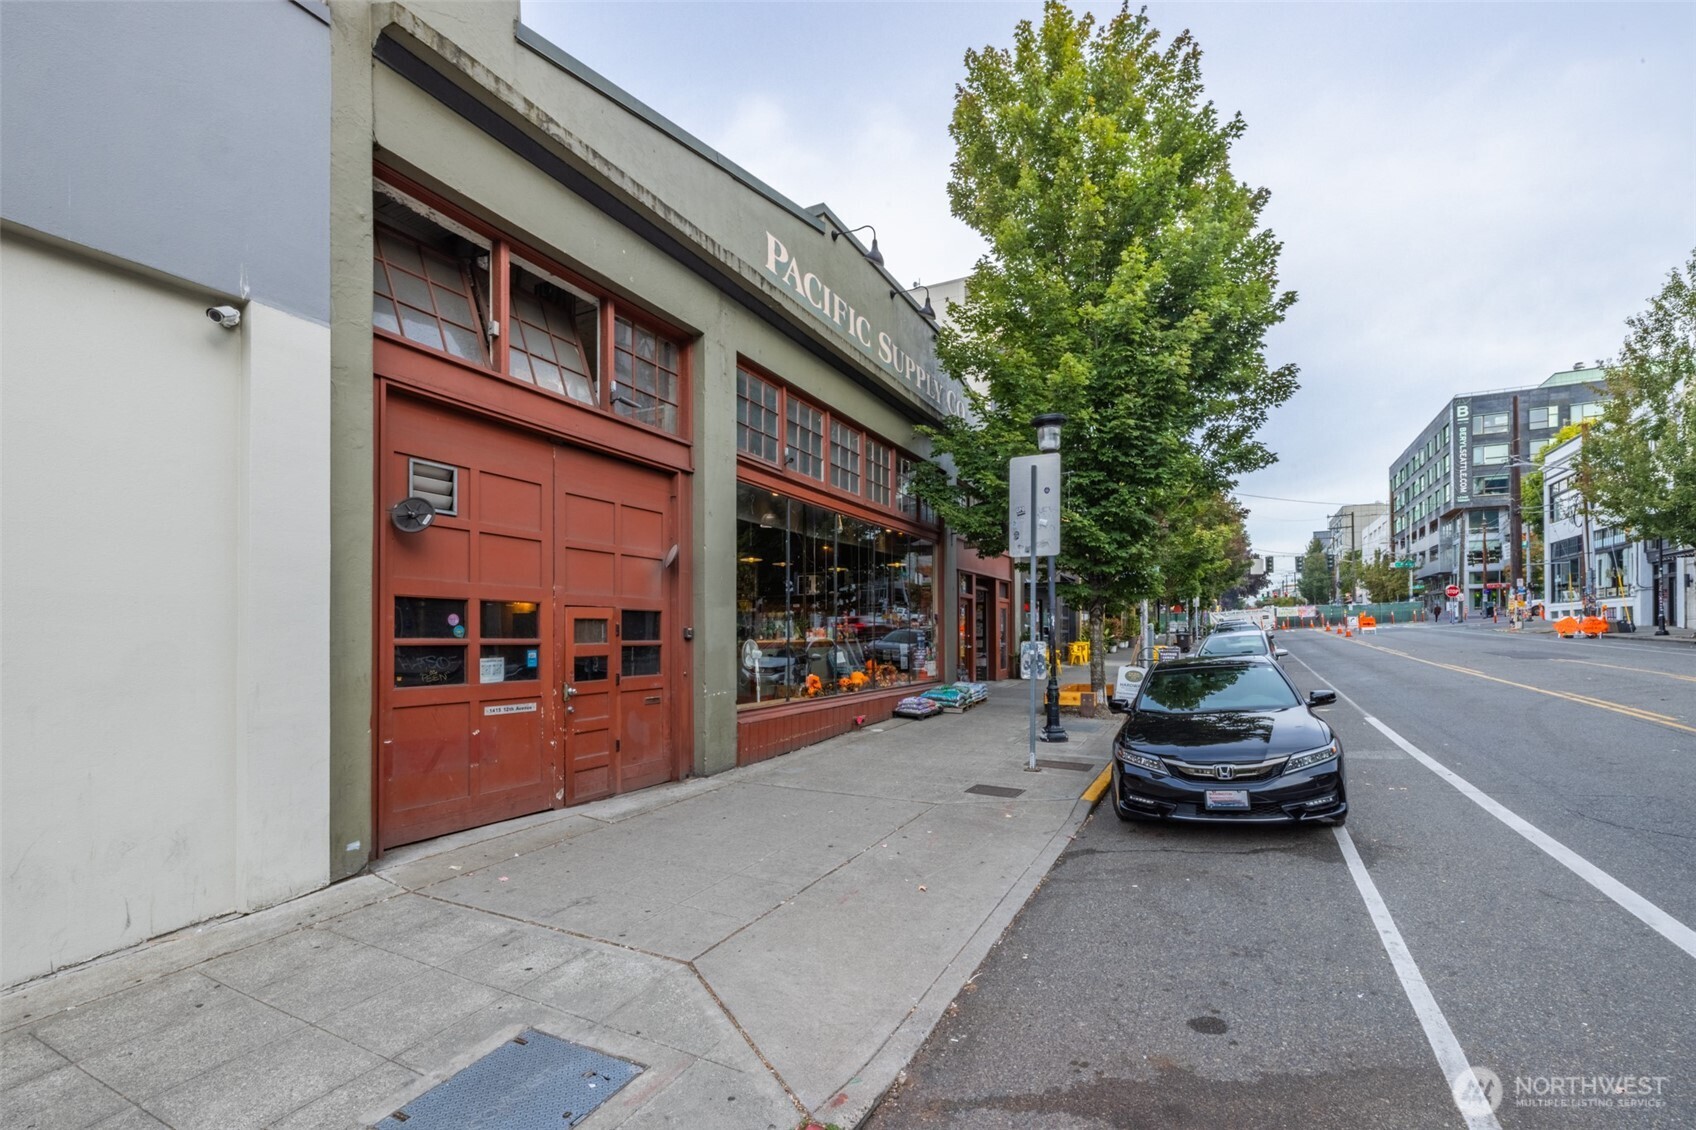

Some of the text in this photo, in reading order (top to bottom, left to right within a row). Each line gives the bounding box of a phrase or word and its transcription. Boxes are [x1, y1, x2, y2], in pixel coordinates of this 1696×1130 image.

[765, 230, 871, 348] PACIFIC
[878, 331, 943, 403] SUPPLY
[1456, 405, 1469, 418] B
[1459, 427, 1468, 493] BERYLSEATTLE.COM
